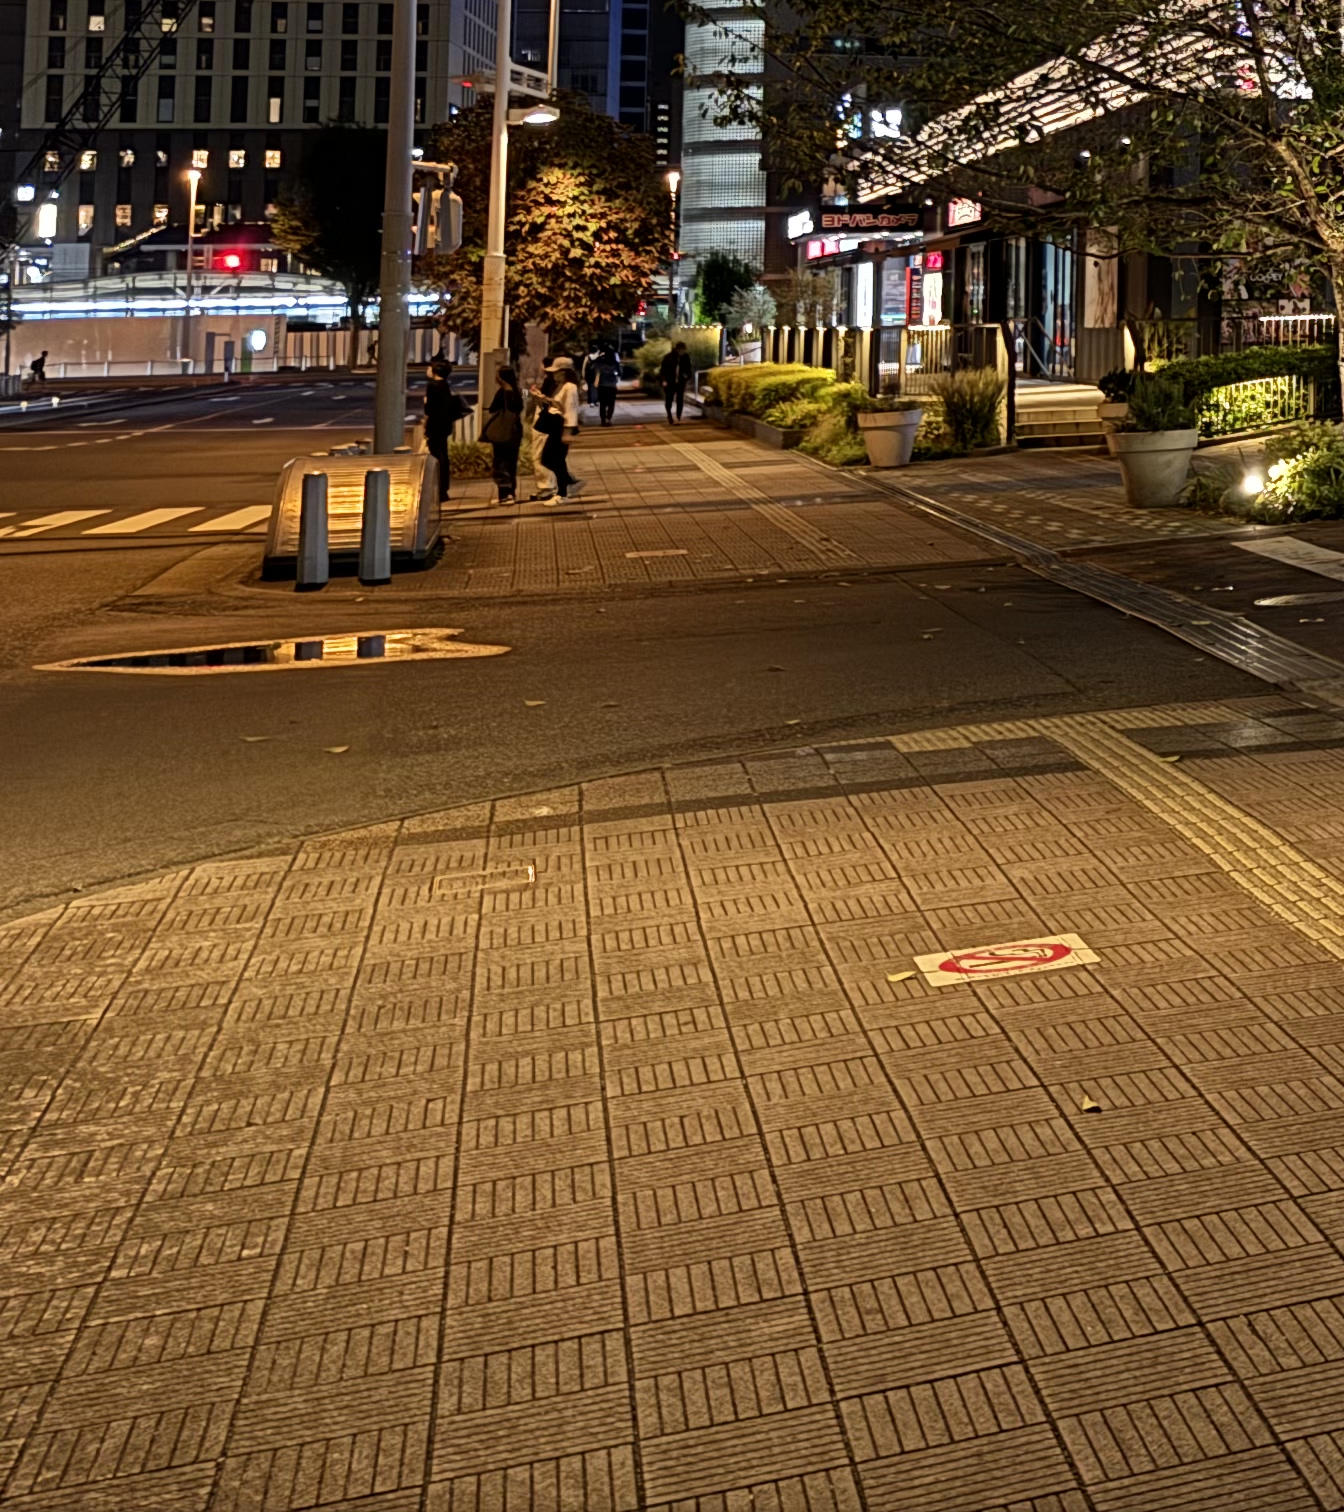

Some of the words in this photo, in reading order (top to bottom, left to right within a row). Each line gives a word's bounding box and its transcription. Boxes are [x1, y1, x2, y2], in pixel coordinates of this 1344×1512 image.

[822, 213, 919, 228] ヨドバシカメラ
